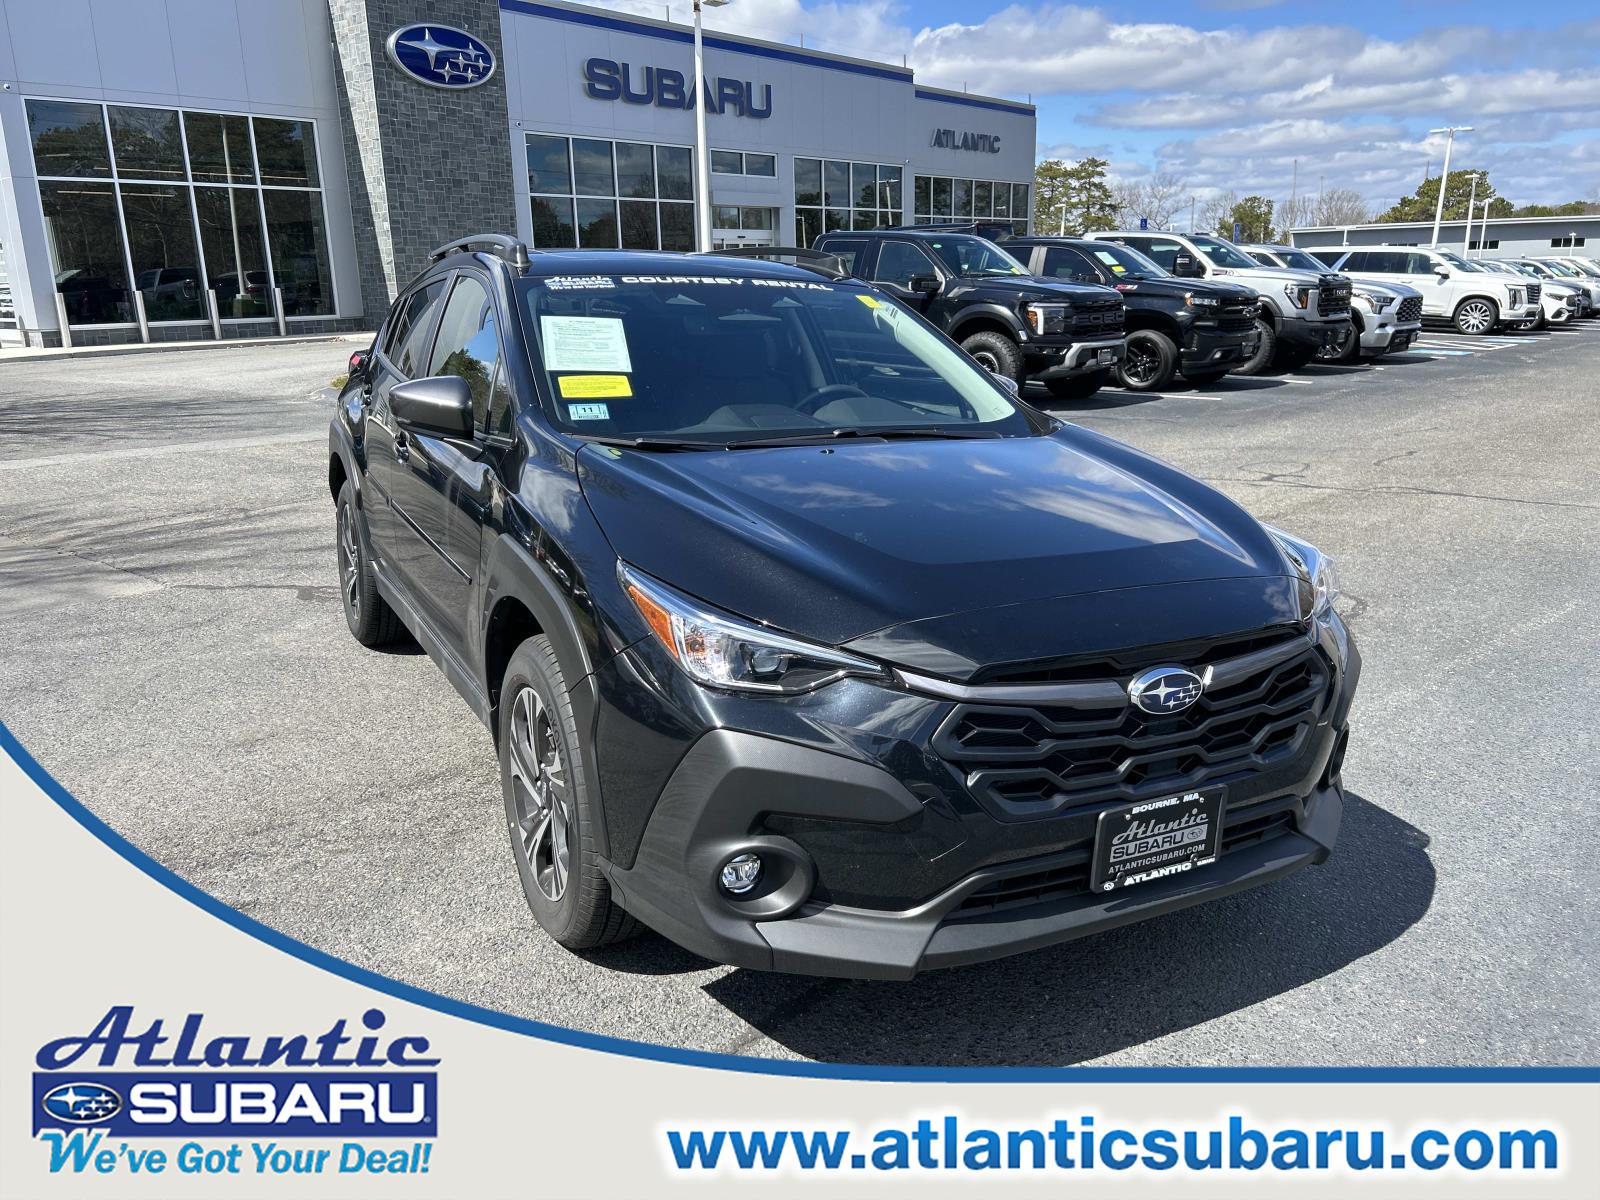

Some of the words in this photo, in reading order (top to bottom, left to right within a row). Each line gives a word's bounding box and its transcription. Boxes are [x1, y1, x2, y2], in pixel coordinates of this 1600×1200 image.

[585, 57, 772, 119] SUBARU
[932, 128, 1001, 154] ATLANTIC
[621, 276, 744, 284] COURTESY
[752, 279, 834, 291] RENTAL
[1132, 798, 1180, 815] BOURNE,
[1182, 792, 1199, 803] MA
[1112, 808, 1209, 845] Atlantic
[1108, 843, 1206, 875] ATLANTICSUBARU.COM
[1112, 831, 1184, 860] SUBARU
[1123, 862, 1192, 887] ATLANTIC
